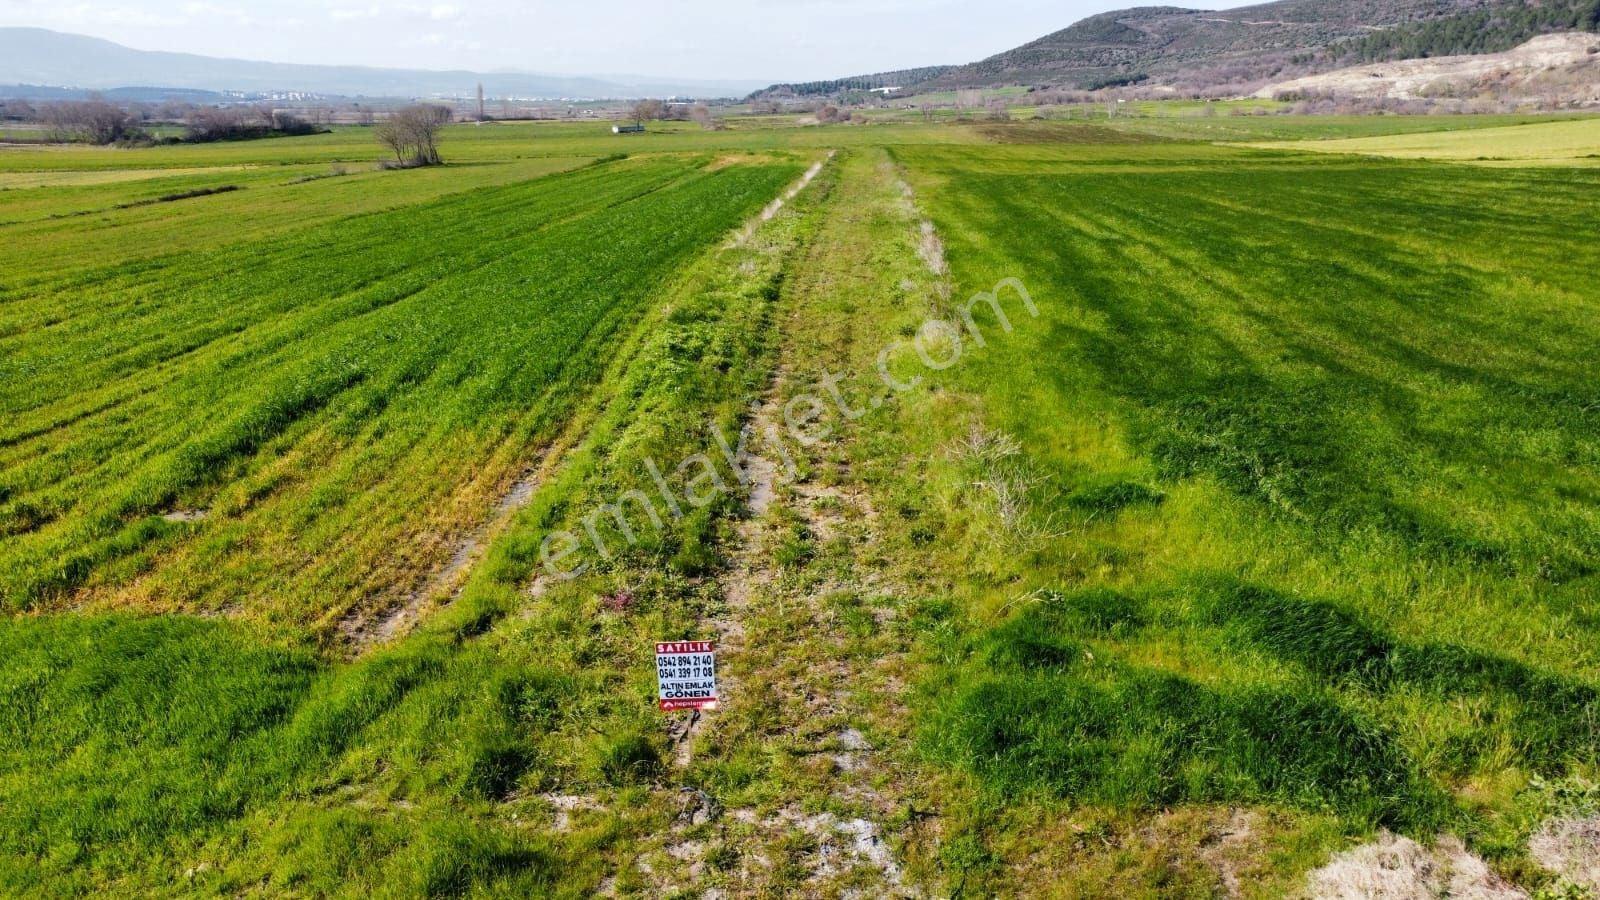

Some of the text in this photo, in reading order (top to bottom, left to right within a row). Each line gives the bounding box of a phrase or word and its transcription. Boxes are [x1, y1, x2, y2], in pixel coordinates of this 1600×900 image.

[657, 643, 710, 652] SATILIK
[658, 655, 712, 667] 0542 894 21 40
[659, 667, 712, 678] 0541 339 17 08
[661, 682, 683, 690] ALTIN
[665, 690, 710, 698] GÖNEN
